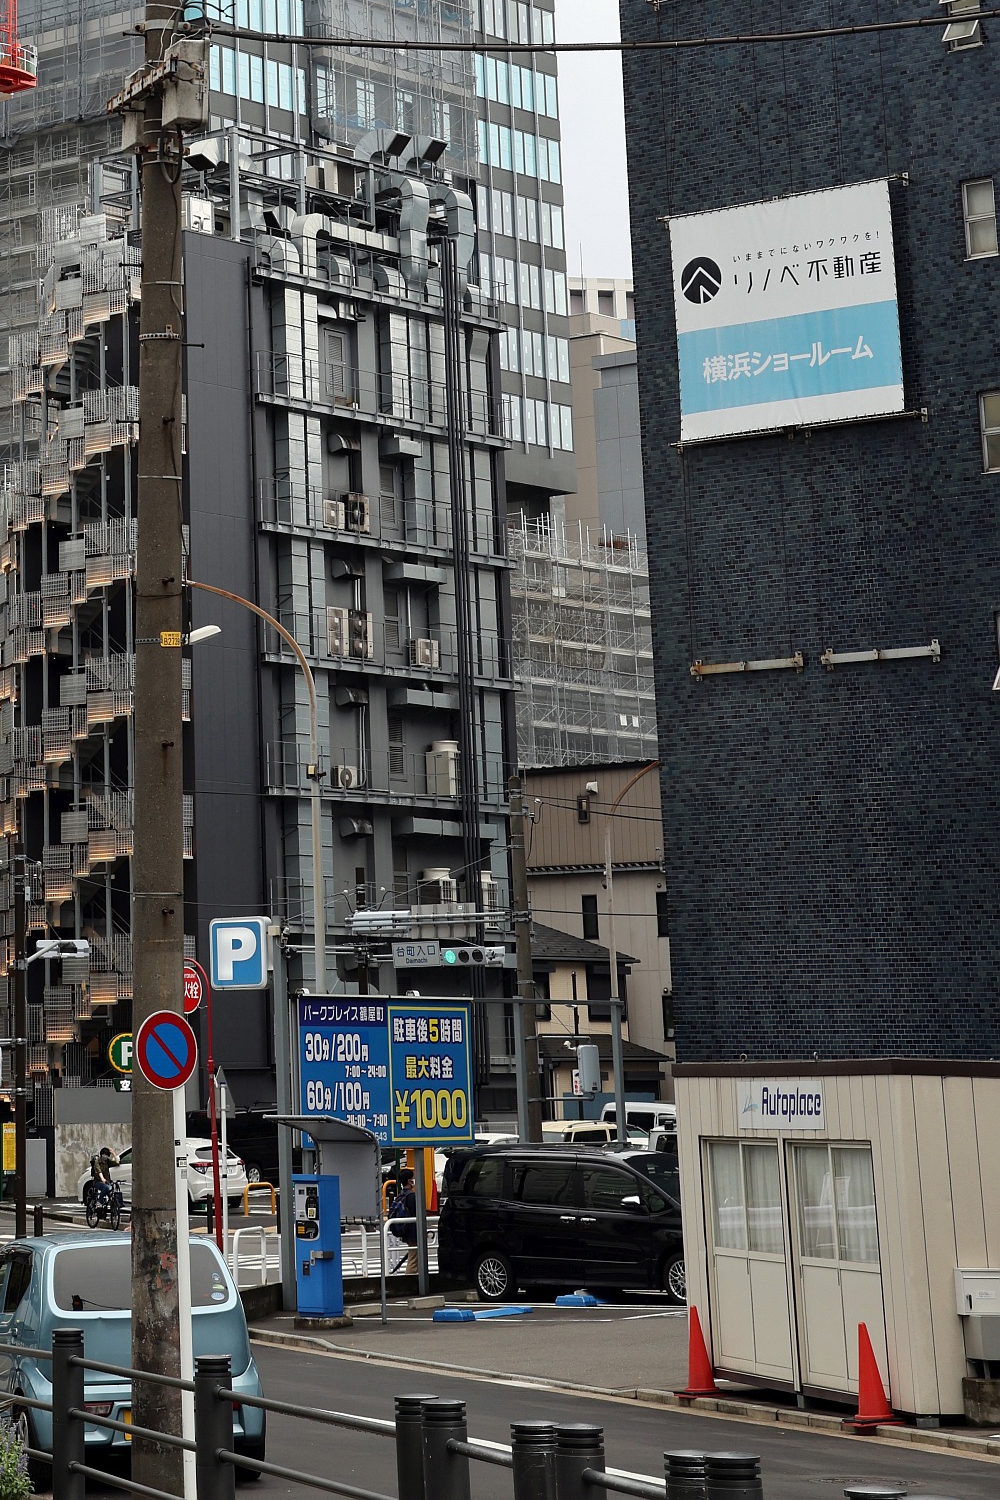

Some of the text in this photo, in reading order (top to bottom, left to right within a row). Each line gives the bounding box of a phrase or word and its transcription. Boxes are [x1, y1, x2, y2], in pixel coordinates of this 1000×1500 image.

[733, 251, 882, 294] リノベ不動産
[702, 335, 874, 384] 横浜ショールーム
[216, 927, 257, 981] P
[396, 945, 436, 957] 台町入口
[184, 981, 199, 999] 火栓
[303, 1005, 384, 1022] パークプレイス鶴屋町
[393, 1018, 463, 1043] 駐車後5時間
[405, 1056, 453, 1079] 最大料金
[395, 1088, 467, 1130] ¥1000
[761, 1086, 822, 1122] Autoplace
